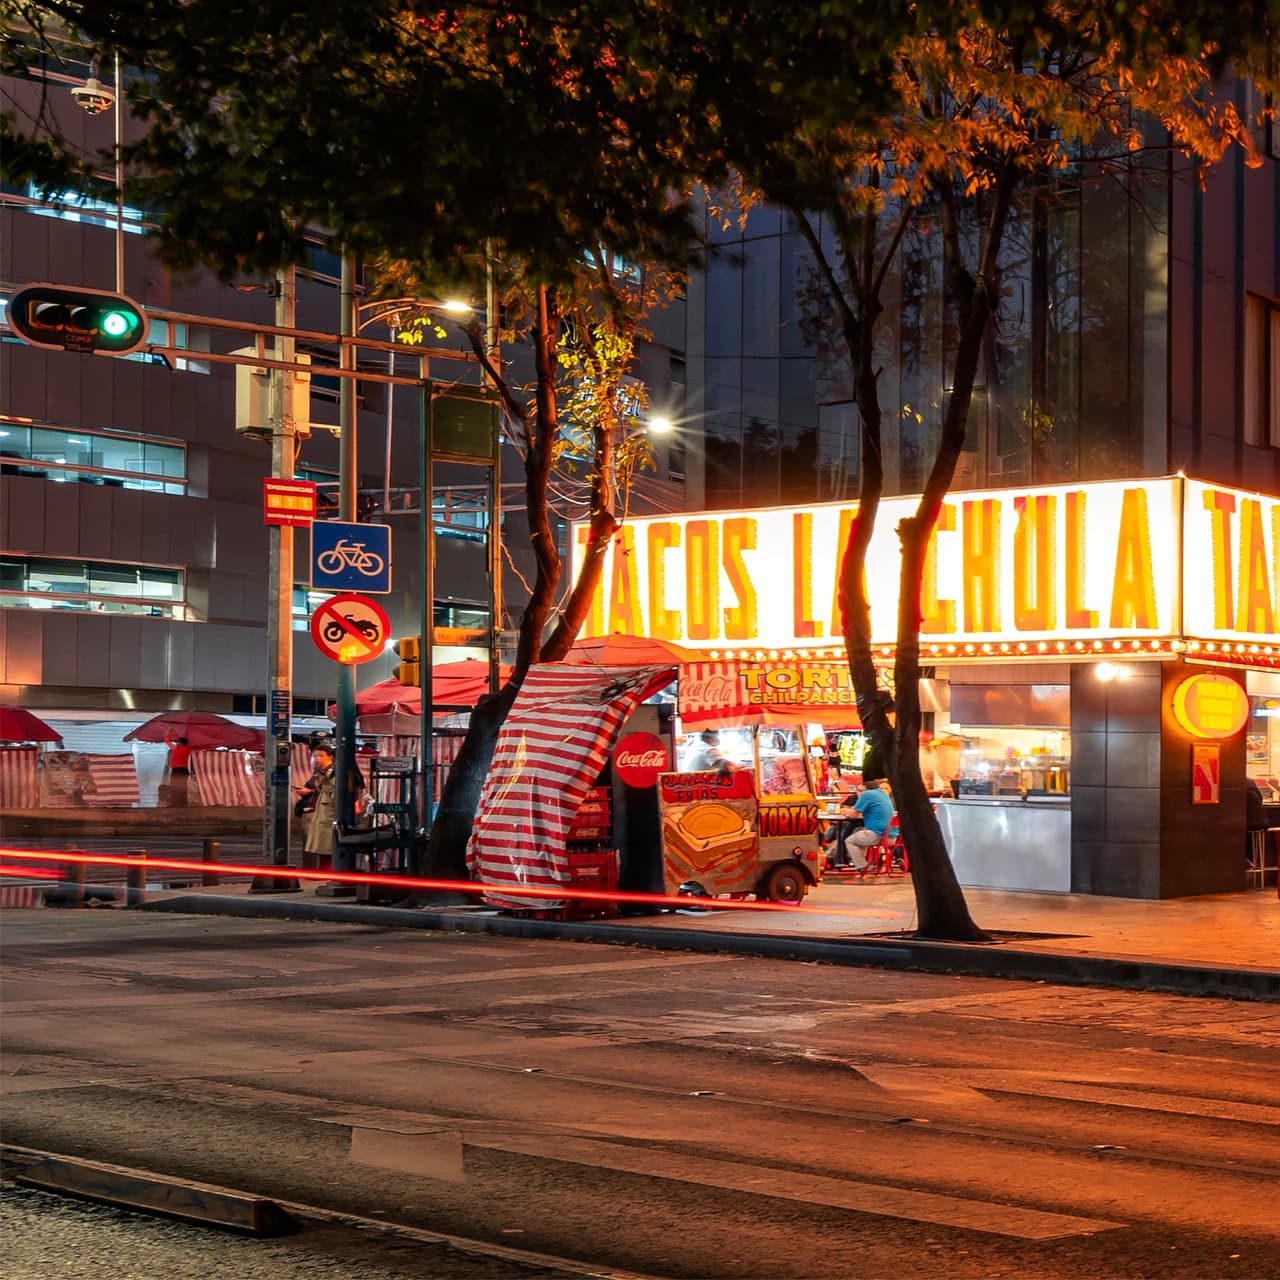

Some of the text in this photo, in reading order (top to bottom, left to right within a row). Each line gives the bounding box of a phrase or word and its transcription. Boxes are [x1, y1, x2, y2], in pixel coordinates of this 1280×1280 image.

[739, 668, 895, 690] TORT
[749, 690, 857, 704] CHILPANCI
[616, 750, 666, 768] Coca-Cola
[758, 805, 820, 837] TORTAS
